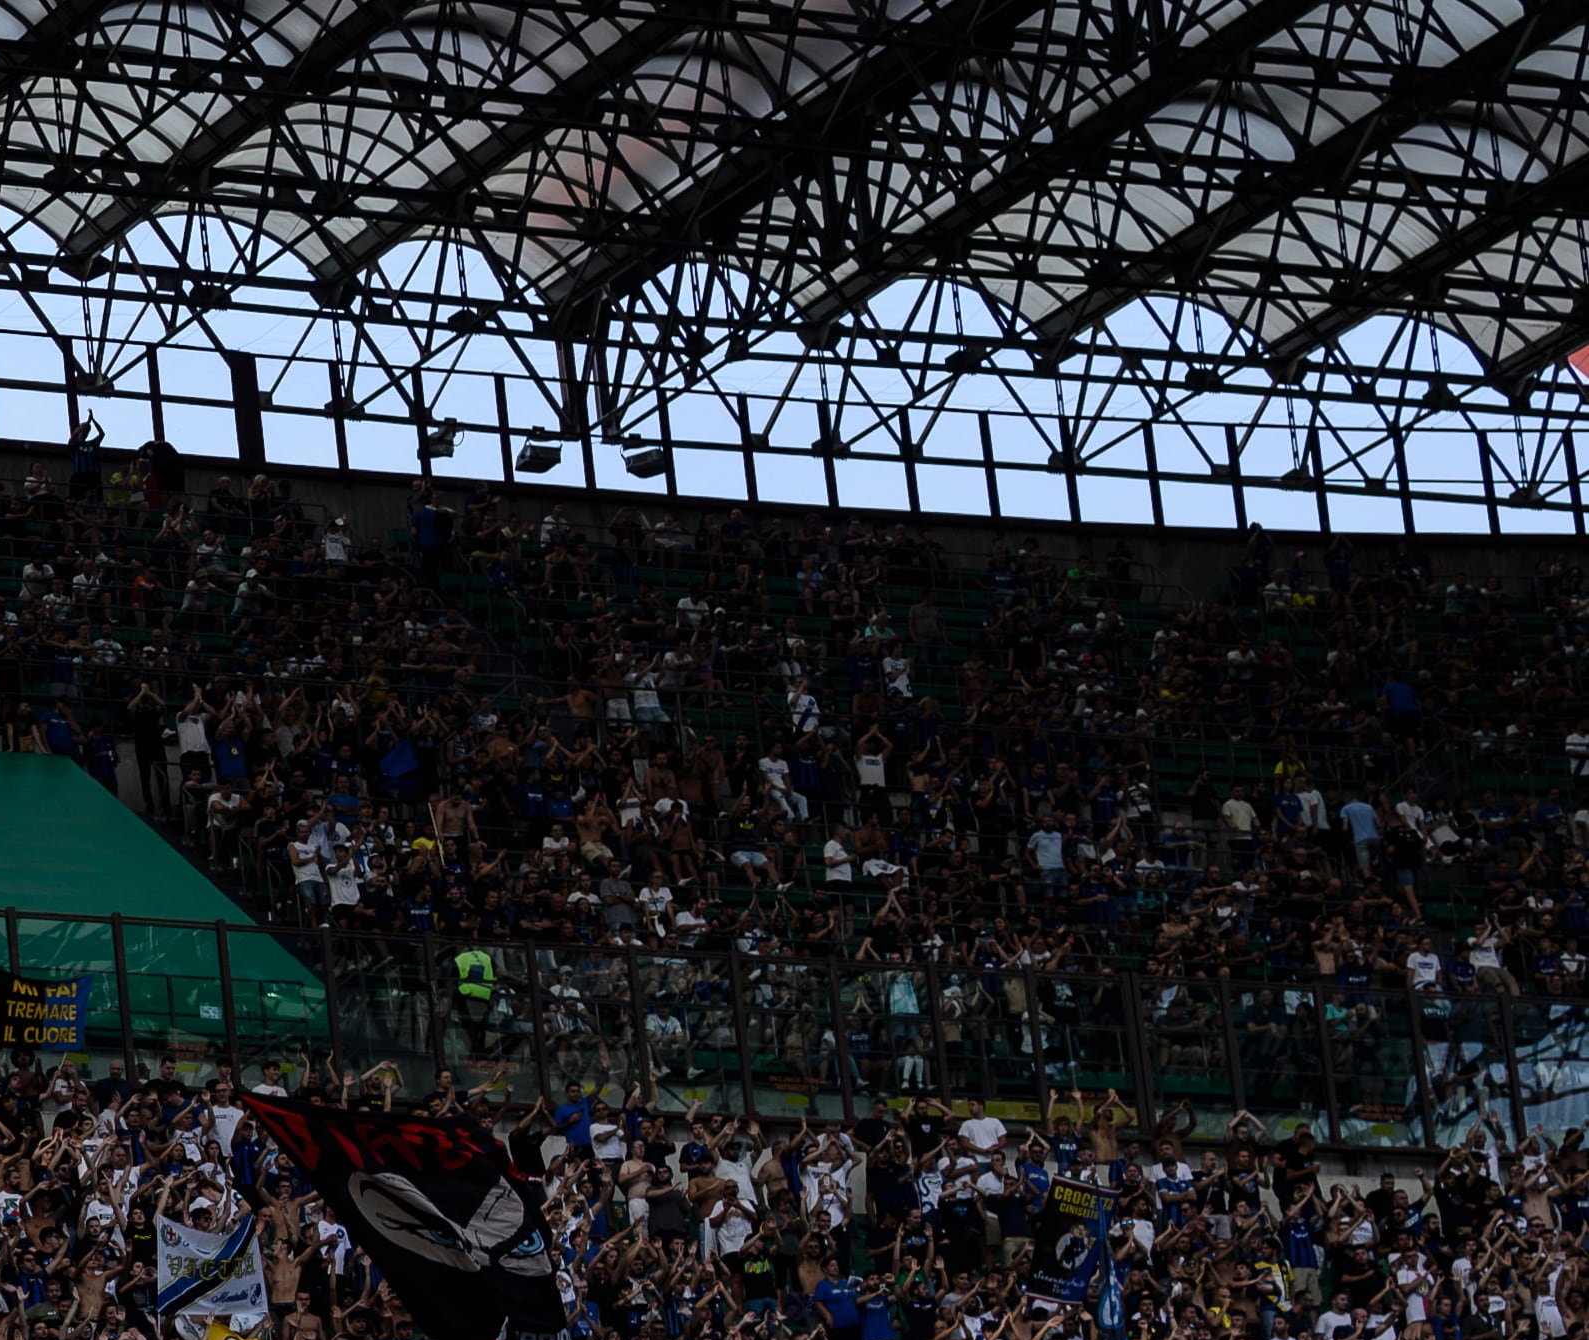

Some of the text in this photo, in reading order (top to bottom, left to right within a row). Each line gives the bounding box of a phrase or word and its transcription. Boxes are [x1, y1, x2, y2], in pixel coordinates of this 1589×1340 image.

[6, 999, 78, 1021] TREMARE
[4, 1025, 78, 1044] IL CUORE
